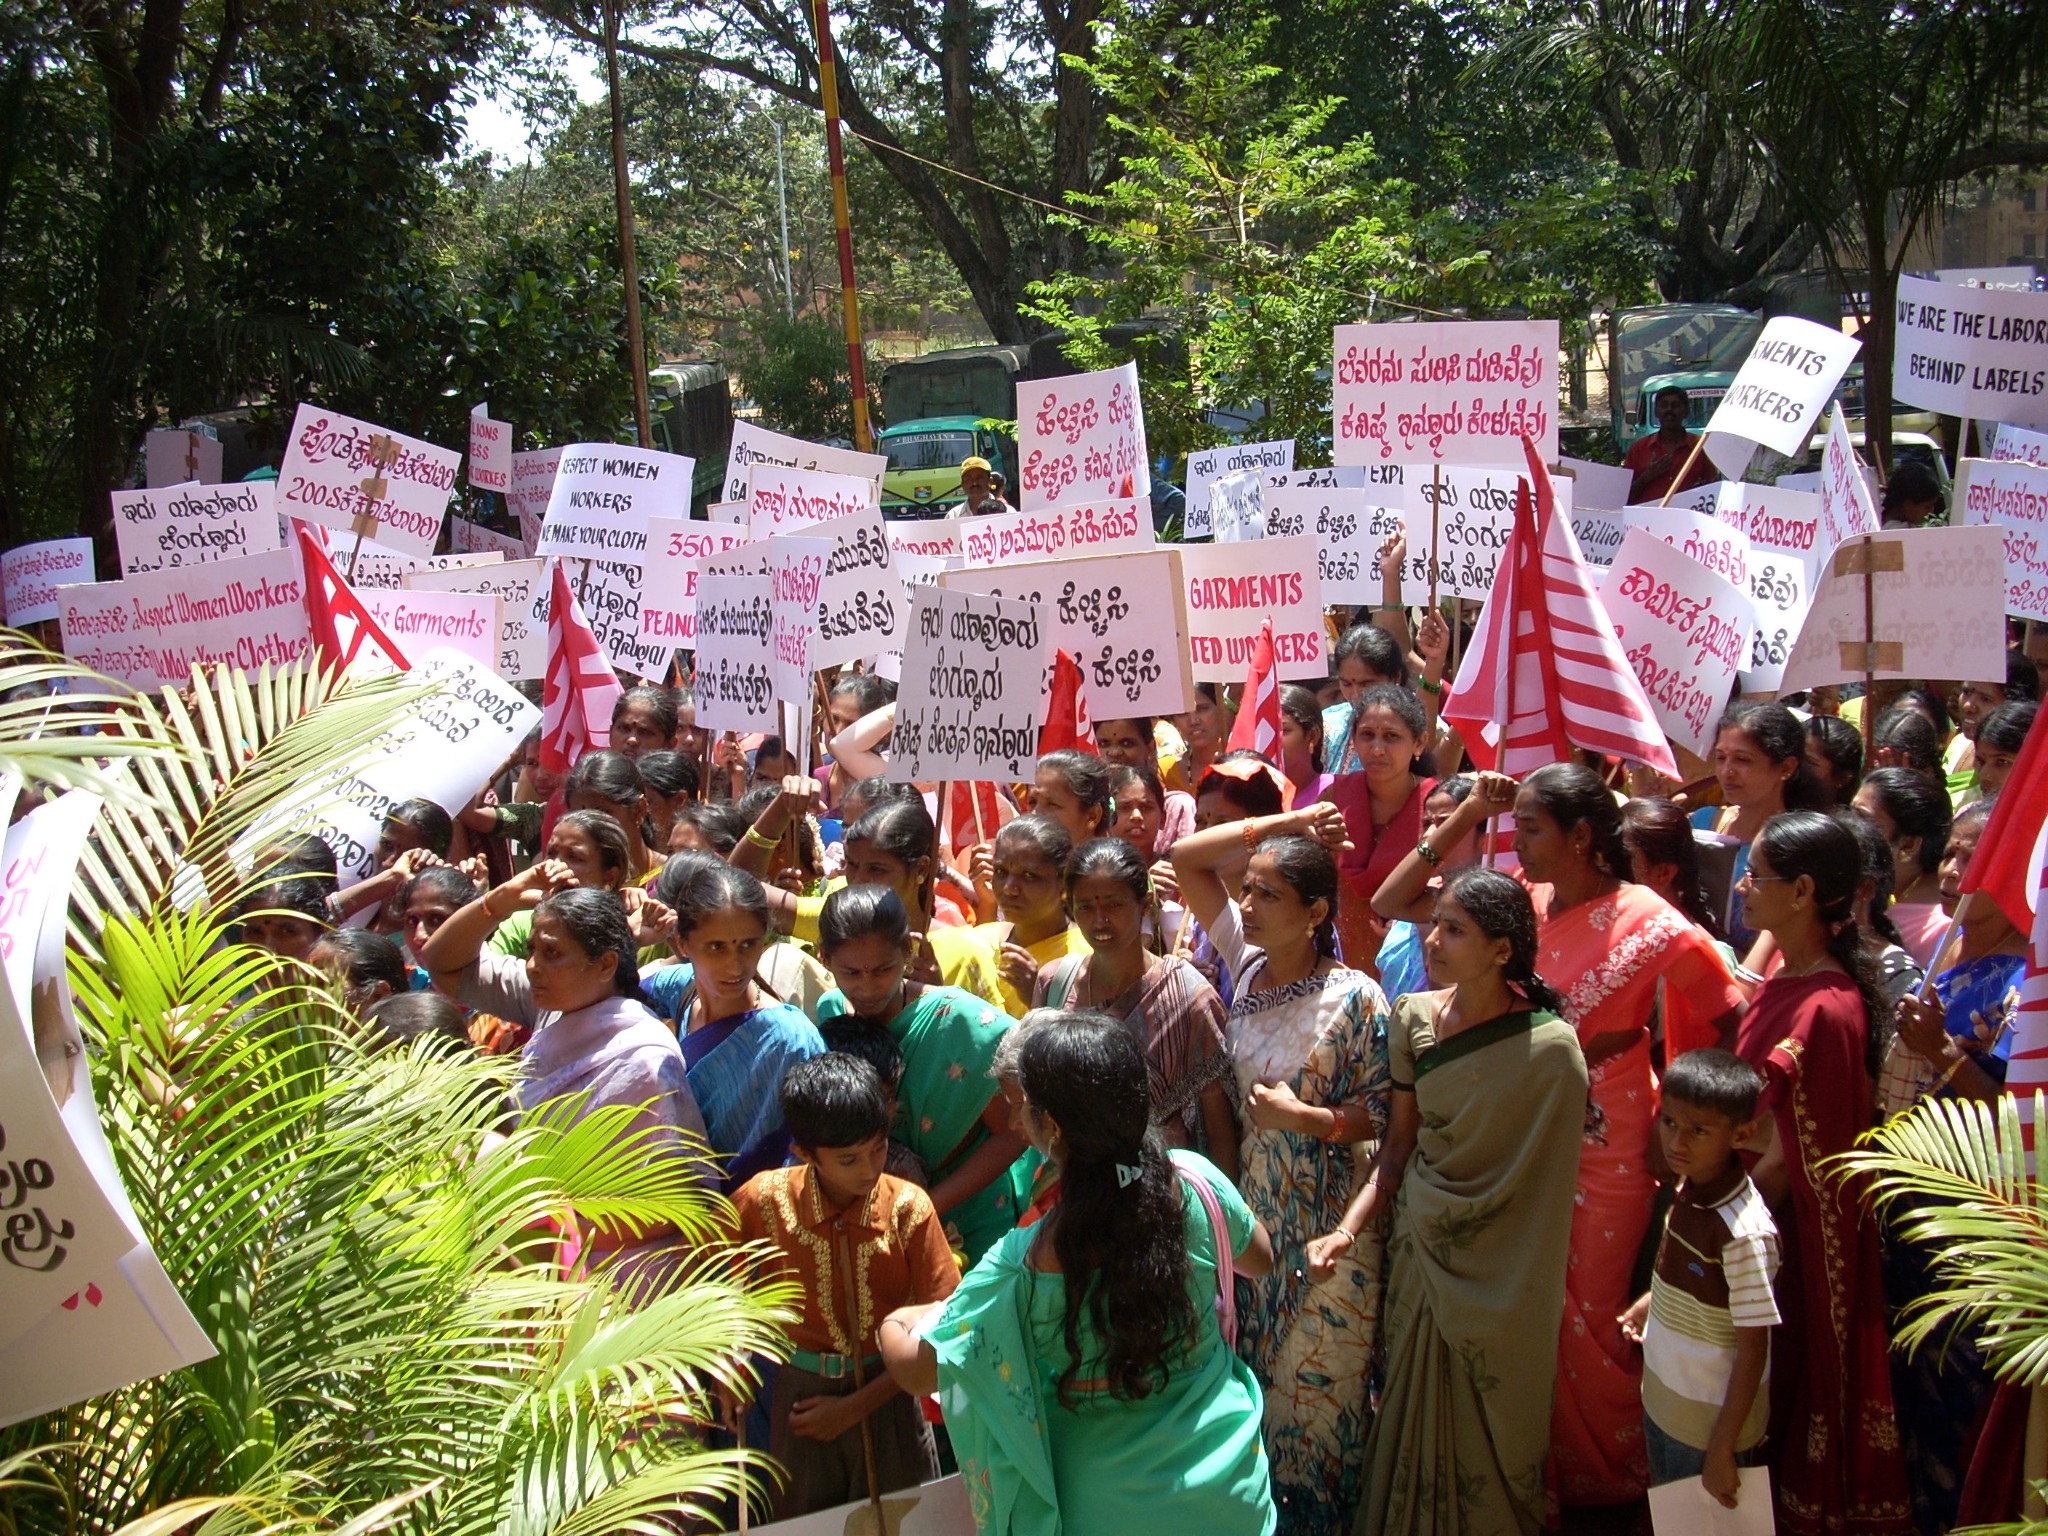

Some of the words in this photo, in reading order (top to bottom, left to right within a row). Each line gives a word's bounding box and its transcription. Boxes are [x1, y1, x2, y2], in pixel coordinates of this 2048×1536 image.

[1898, 300, 1915, 326] WE
[1918, 305, 1946, 332] ARE
[1953, 311, 1985, 338] THE
[1987, 316, 2048, 345] LABOR
[1910, 353, 1965, 385] BEHIND
[1972, 367, 2045, 395] LABELS
[1725, 385, 1804, 424] WORKERS
[602, 458, 660, 481] WOMEN
[286, 477, 327, 506] 200
[569, 491, 632, 514] WORKERS
[552, 525, 576, 544] MAKE
[580, 526, 607, 550] YOUR
[666, 532, 714, 558] 350
[174, 591, 230, 624] Women
[226, 576, 300, 615] Workers
[1057, 580, 1130, 638] ಹೆಚ್ಚಿಸಿ
[1190, 571, 1303, 610] GARMENTS
[394, 604, 486, 639] Garments
[236, 631, 308, 671] Clothes
[1225, 631, 1319, 665] WOKERS
[1092, 644, 1162, 703] ಹೆಚ್ಚಿಸಿ
